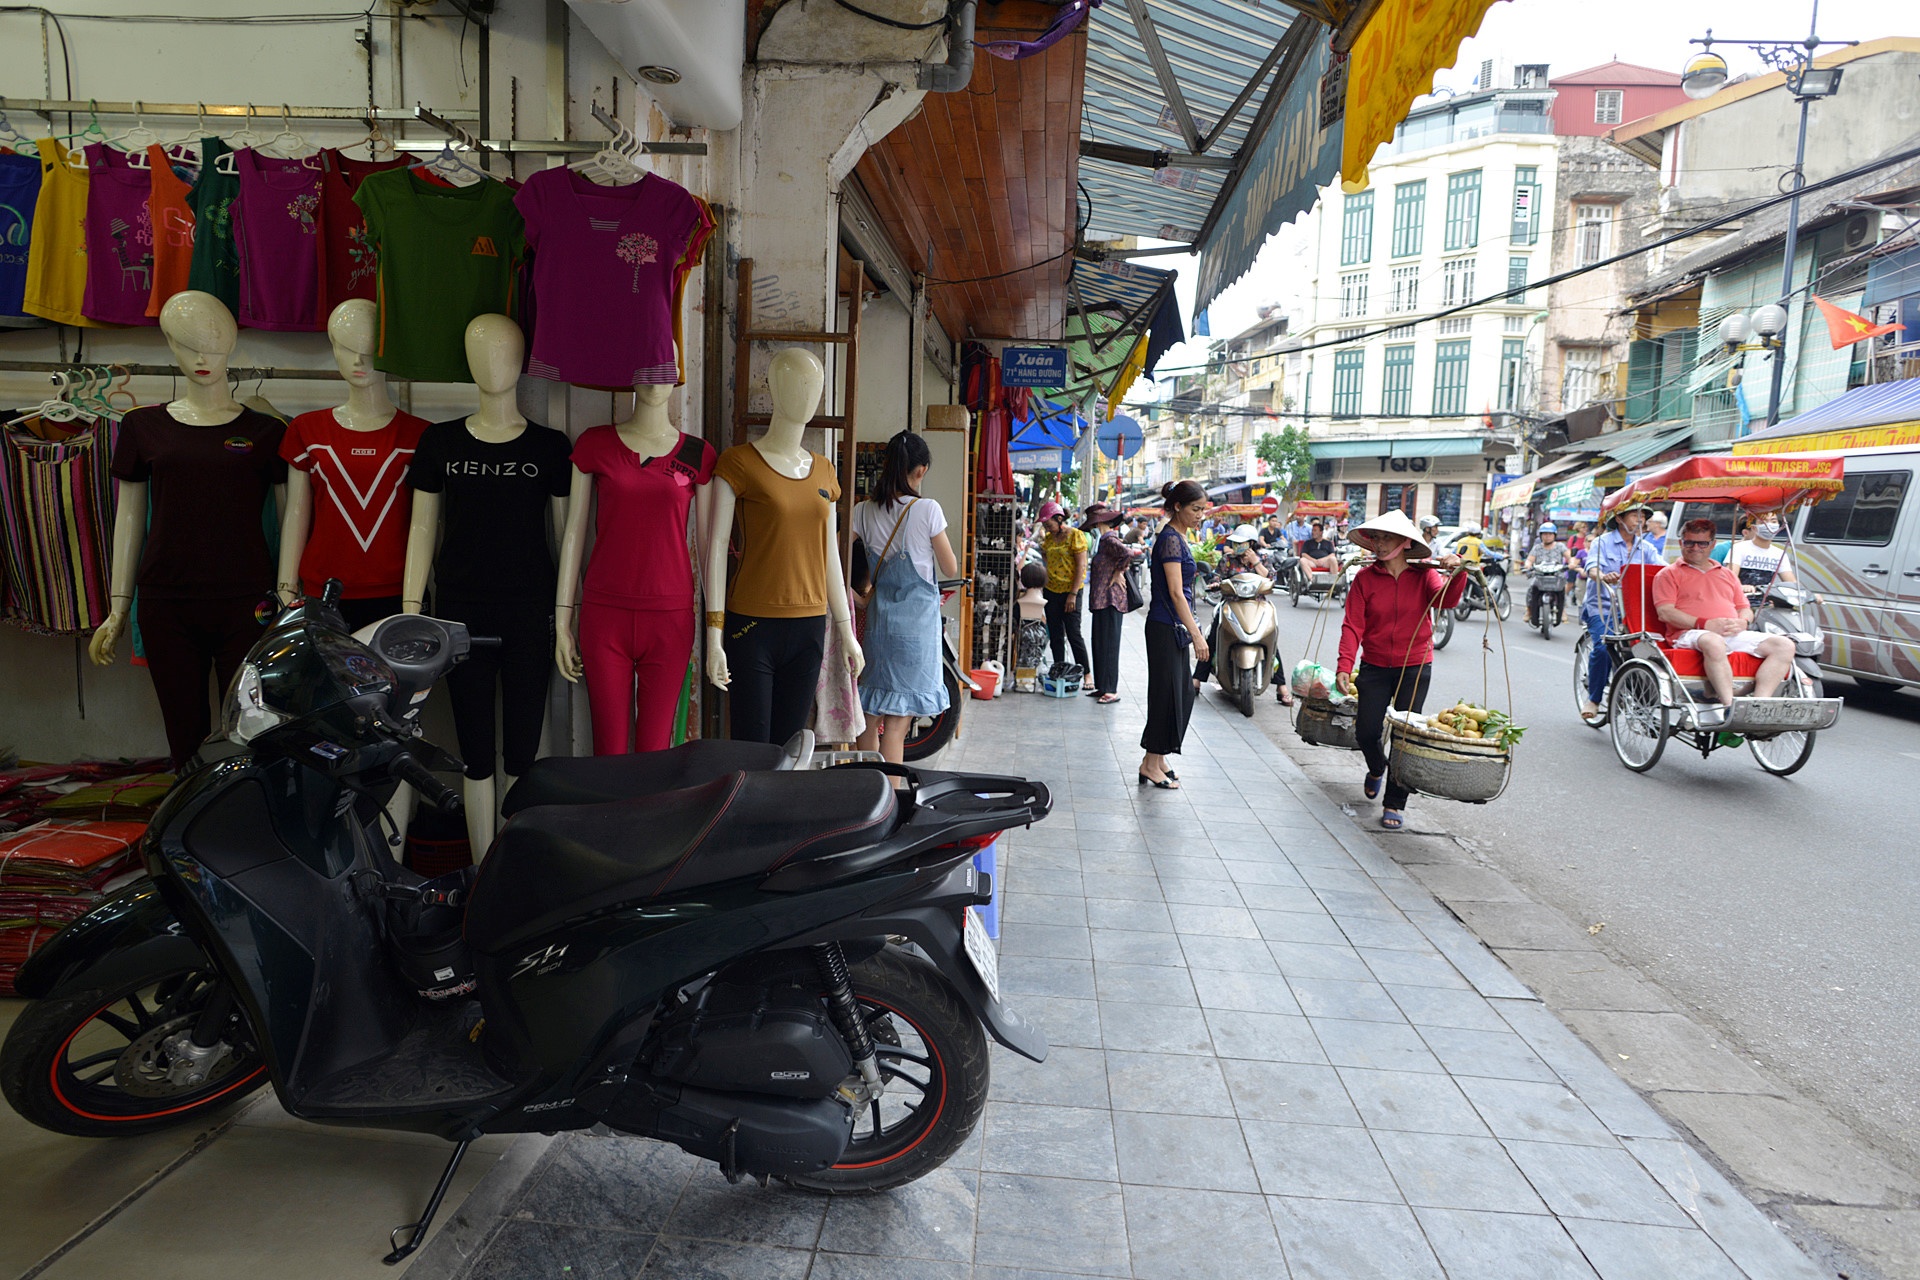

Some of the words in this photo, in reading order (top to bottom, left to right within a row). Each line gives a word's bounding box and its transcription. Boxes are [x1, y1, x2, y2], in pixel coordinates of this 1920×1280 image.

[1016, 353, 1054, 366] Xuân
[1018, 366, 1037, 377] HÀNG
[1038, 367, 1062, 378] ĐƯỜNG
[446, 461, 539, 477] KENZO
[1377, 456, 1427, 473] TQQ
[1725, 460, 1746, 472] LAM
[1749, 460, 1768, 473] ANH
[508, 944, 569, 981] SH
